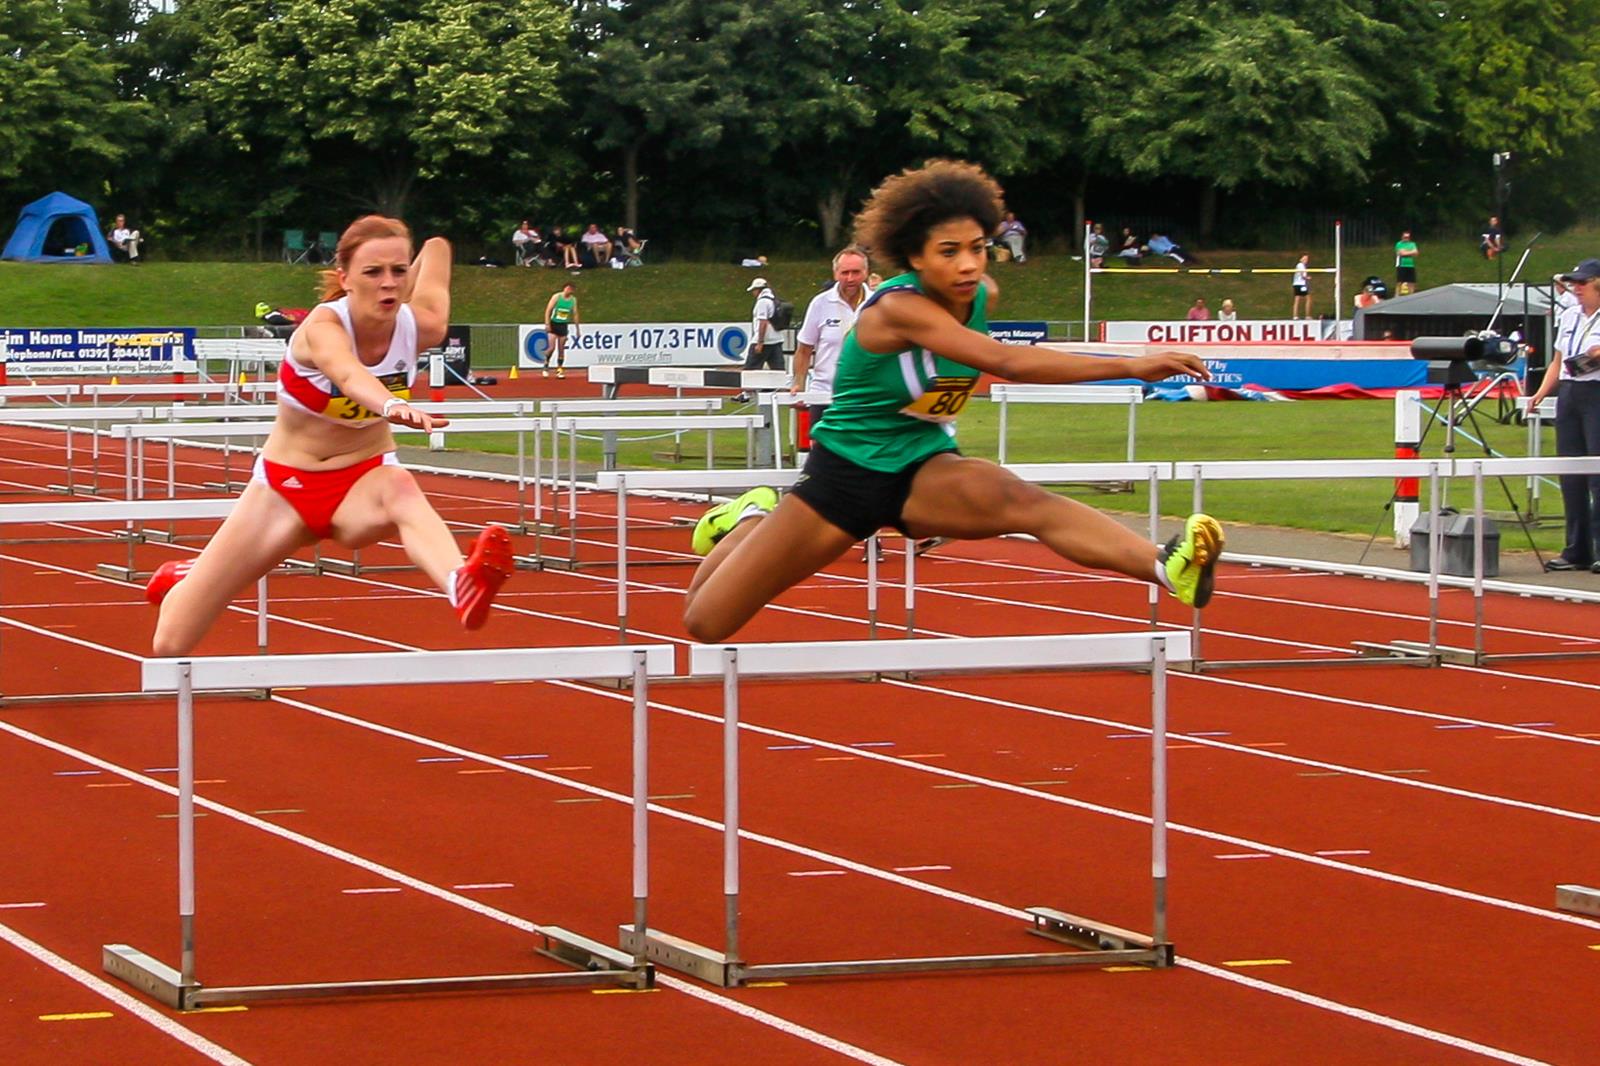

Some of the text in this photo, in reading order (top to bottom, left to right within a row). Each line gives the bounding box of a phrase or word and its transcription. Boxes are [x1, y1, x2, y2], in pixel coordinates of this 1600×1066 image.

[29, 331, 72, 345] Home
[629, 328, 680, 349] 107.3
[684, 328, 714, 348] FM
[1147, 324, 1316, 342] CLIFTON HILL
[928, 391, 969, 415] 80
